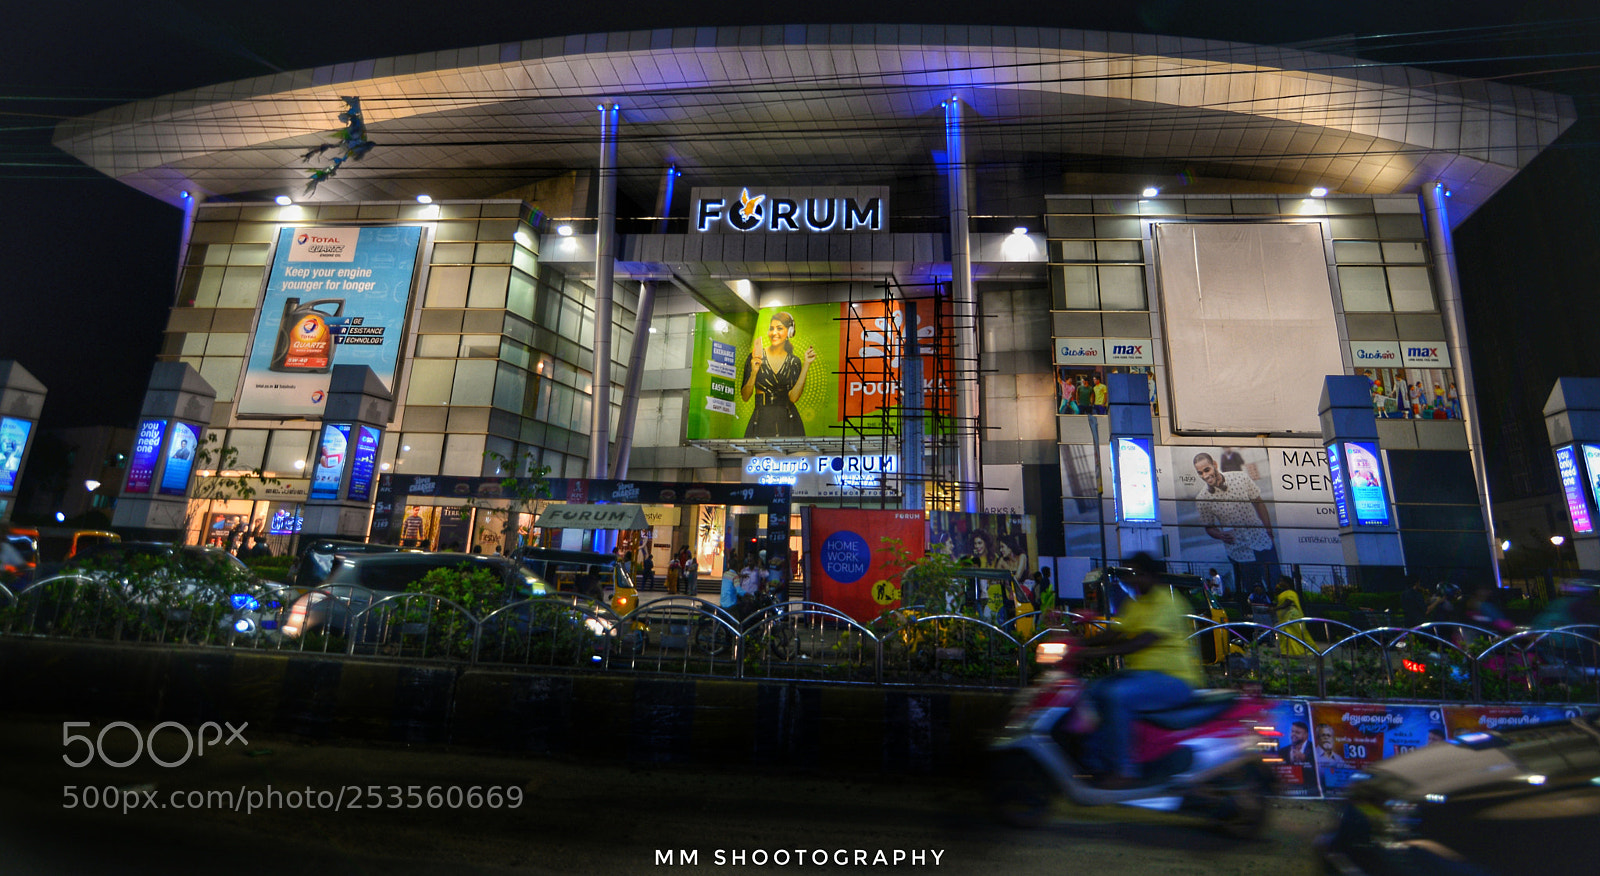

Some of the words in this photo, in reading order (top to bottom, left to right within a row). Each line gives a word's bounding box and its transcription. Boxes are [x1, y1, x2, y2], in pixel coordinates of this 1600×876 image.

[697, 197, 881, 231] FORUM
[308, 245, 345, 253] QUARTZ
[285, 266, 310, 279] Keep
[312, 268, 335, 279] your
[337, 267, 372, 279] engine
[281, 280, 323, 292] younger
[325, 279, 341, 290] for
[342, 280, 376, 292] longer
[293, 341, 327, 349] QUARTZ
[1112, 345, 1142, 355] max
[1061, 346, 1098, 356] மேக்ஸ்
[1357, 349, 1395, 359] மேக்ஸ்
[1407, 347, 1438, 357] max
[711, 382, 724, 392] EASY
[849, 378, 949, 396] POORKA
[142, 422, 159, 431] you
[140, 429, 160, 439] only
[138, 437, 160, 446] need
[136, 445, 153, 453] one
[1556, 451, 1569, 461] you
[817, 456, 893, 472] FORUM
[1559, 459, 1573, 470] only
[1561, 465, 1576, 478] need
[1563, 476, 1575, 486] one
[549, 510, 626, 521] FORUM
[827, 540, 859, 551] HOME
[827, 551, 859, 562] WORK
[827, 562, 864, 573] FORUM
[1349, 745, 1366, 758] 30
